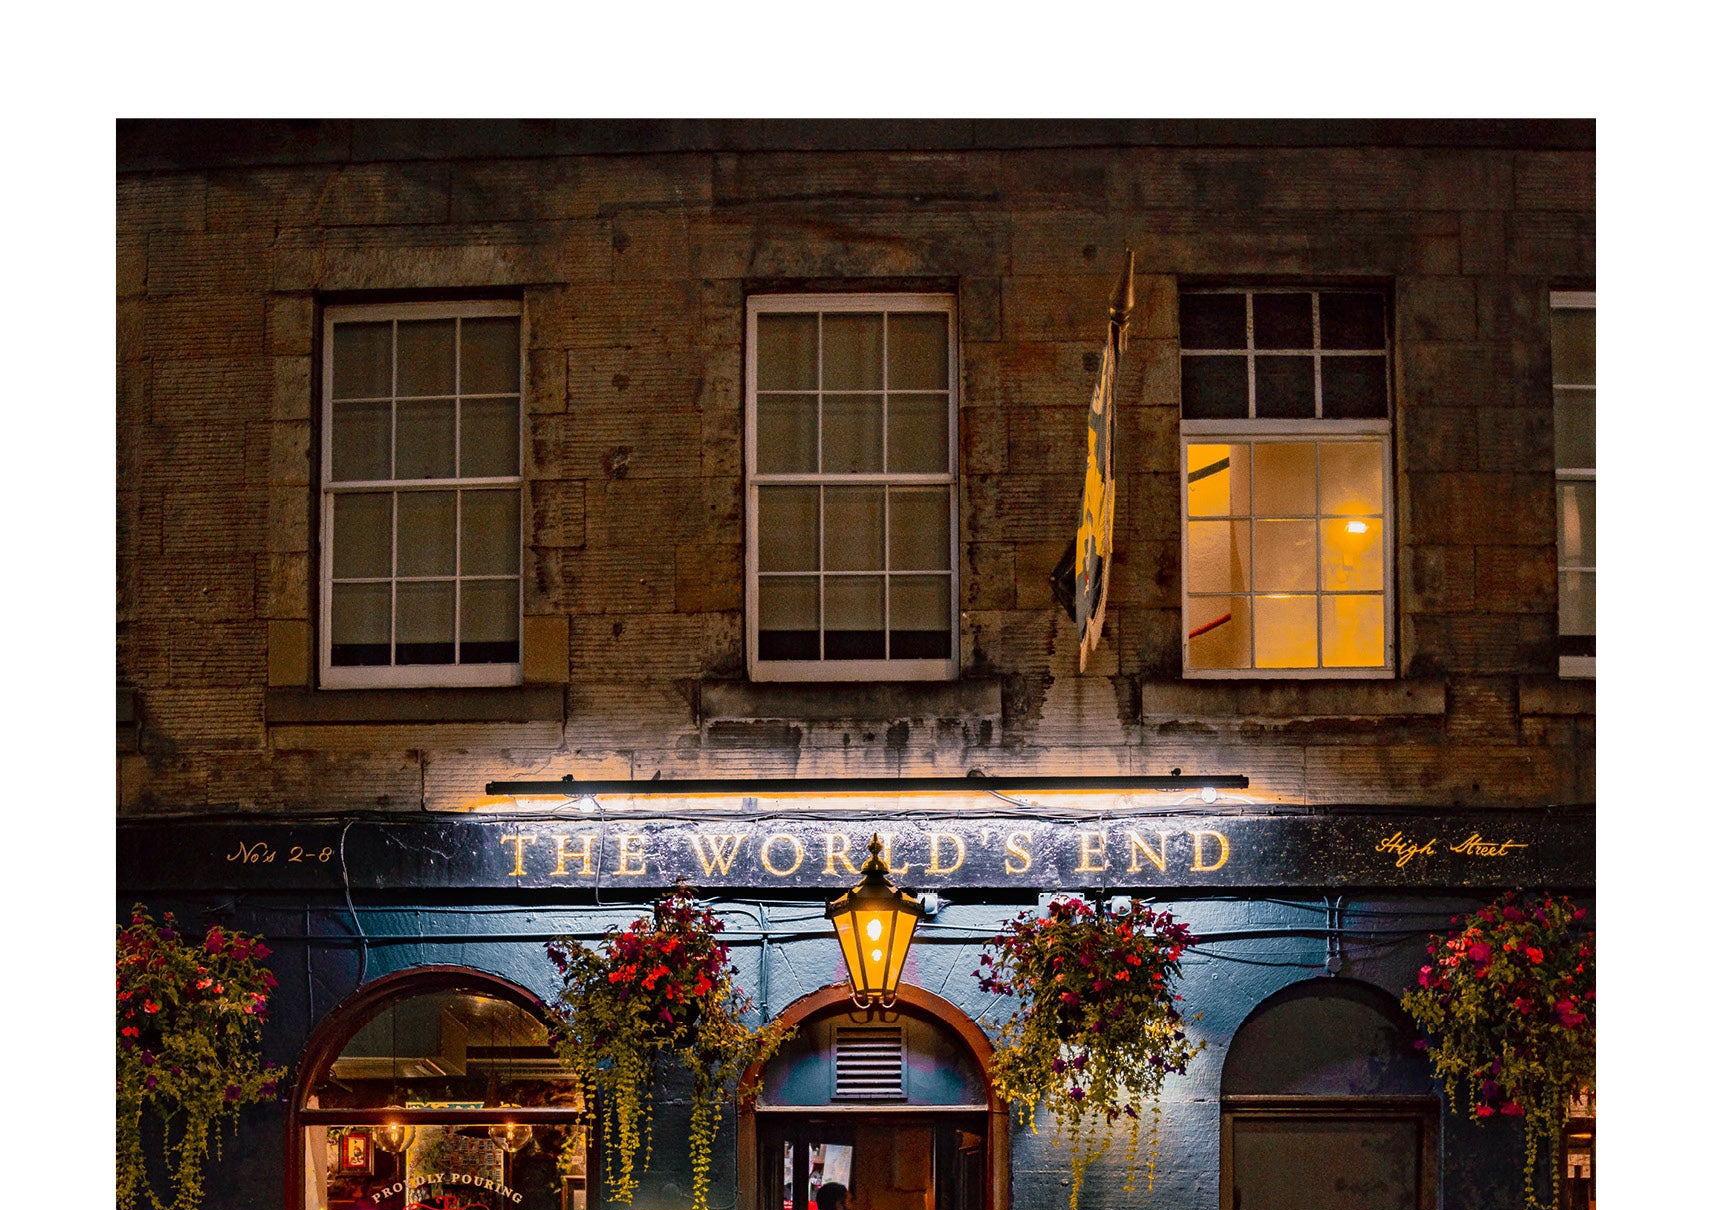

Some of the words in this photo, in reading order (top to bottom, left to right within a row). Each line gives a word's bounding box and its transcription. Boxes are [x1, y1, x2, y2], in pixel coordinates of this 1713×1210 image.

[288, 846, 333, 863] 2-8
[500, 833, 648, 877] THE
[686, 831, 1033, 877] WORLD'S
[1074, 829, 1231, 875] END
[1375, 831, 1437, 868] High
[1450, 833, 1529, 857] Street
[451, 1173, 524, 1205] POURING
